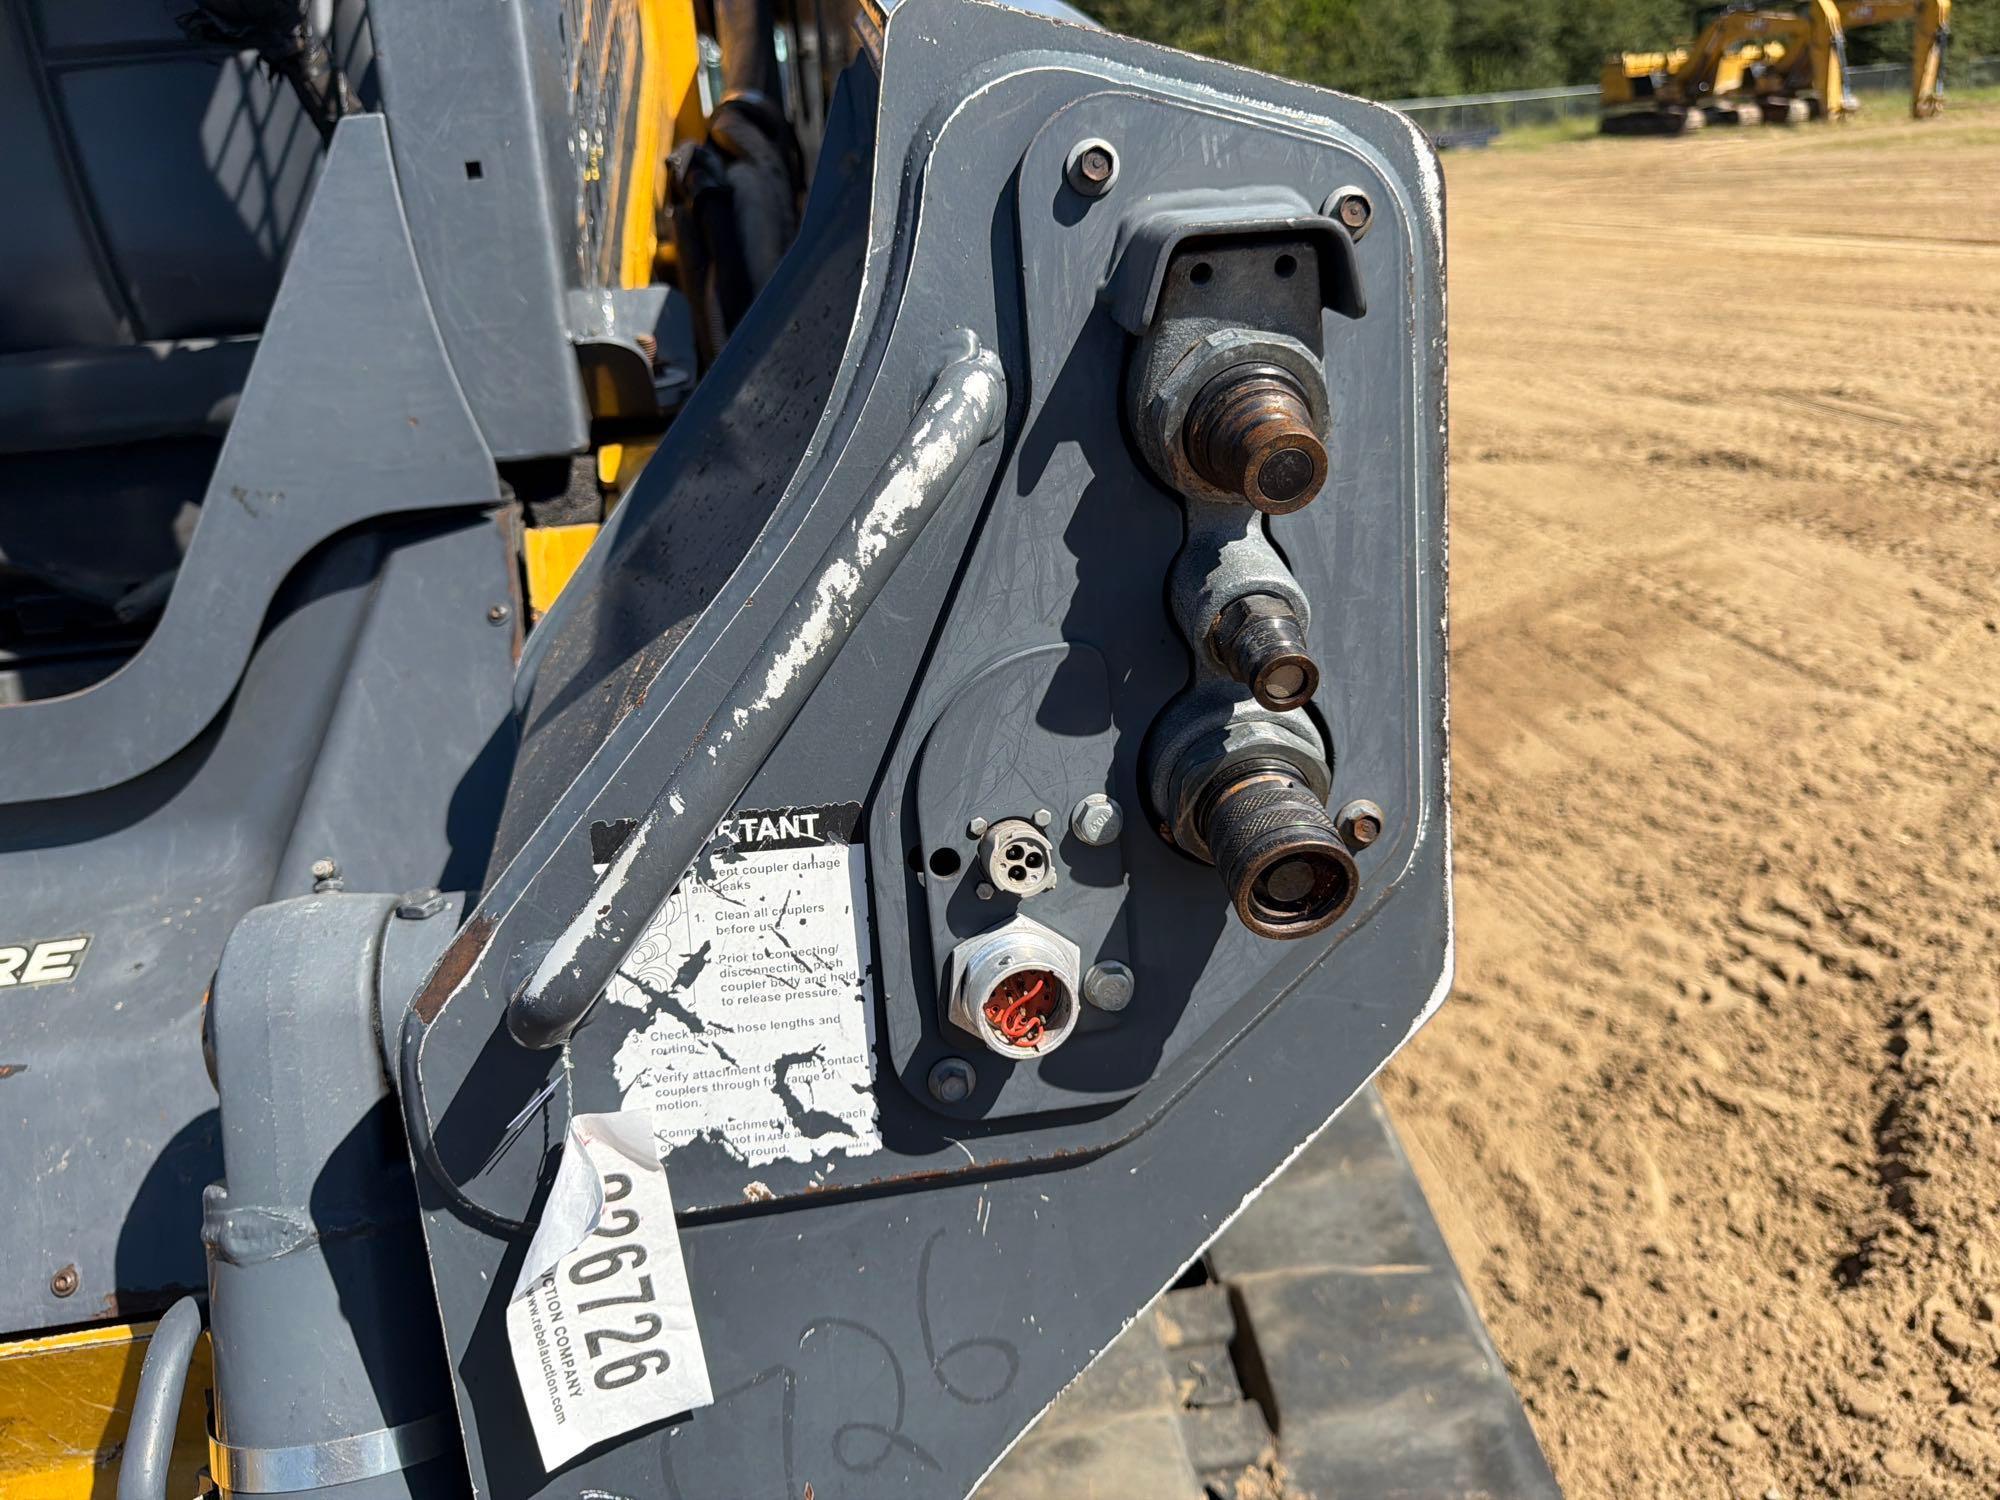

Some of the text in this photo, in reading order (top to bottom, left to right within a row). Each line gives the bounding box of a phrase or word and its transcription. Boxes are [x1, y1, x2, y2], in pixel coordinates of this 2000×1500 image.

[715, 813, 820, 843] RTANT
[742, 863, 788, 878] coupler
[793, 859, 841, 873] damage
[694, 913, 705, 923] 1.
[715, 910, 750, 922] Clean
[754, 908, 768, 918] all
[716, 924, 755, 935] before
[718, 944, 839, 964] Prior to connecting/
[720, 971, 857, 993] coupler body and hold
[722, 988, 842, 1006] to release pressure.
[632, 1034, 643, 1044] 3.
[650, 1030, 689, 1041] Check
[737, 1023, 767, 1034] hose
[770, 1018, 815, 1032] lengths
[818, 1014, 841, 1025] and
[654, 1072, 689, 1084] Verify
[693, 1065, 761, 1080] attachment
[764, 1062, 793, 1073] ds
[797, 1060, 817, 1069] not
[820, 1054, 864, 1067] contact
[655, 1071, 836, 1099] couplers through fu range of
[656, 1100, 702, 1112] motion.
[839, 1109, 867, 1120] each
[732, 1133, 752, 1144] not
[755, 1131, 766, 1142] in
[541, 1267, 583, 1398] UCTION COMPANY
[525, 1286, 567, 1425] www.rebelauction.com
